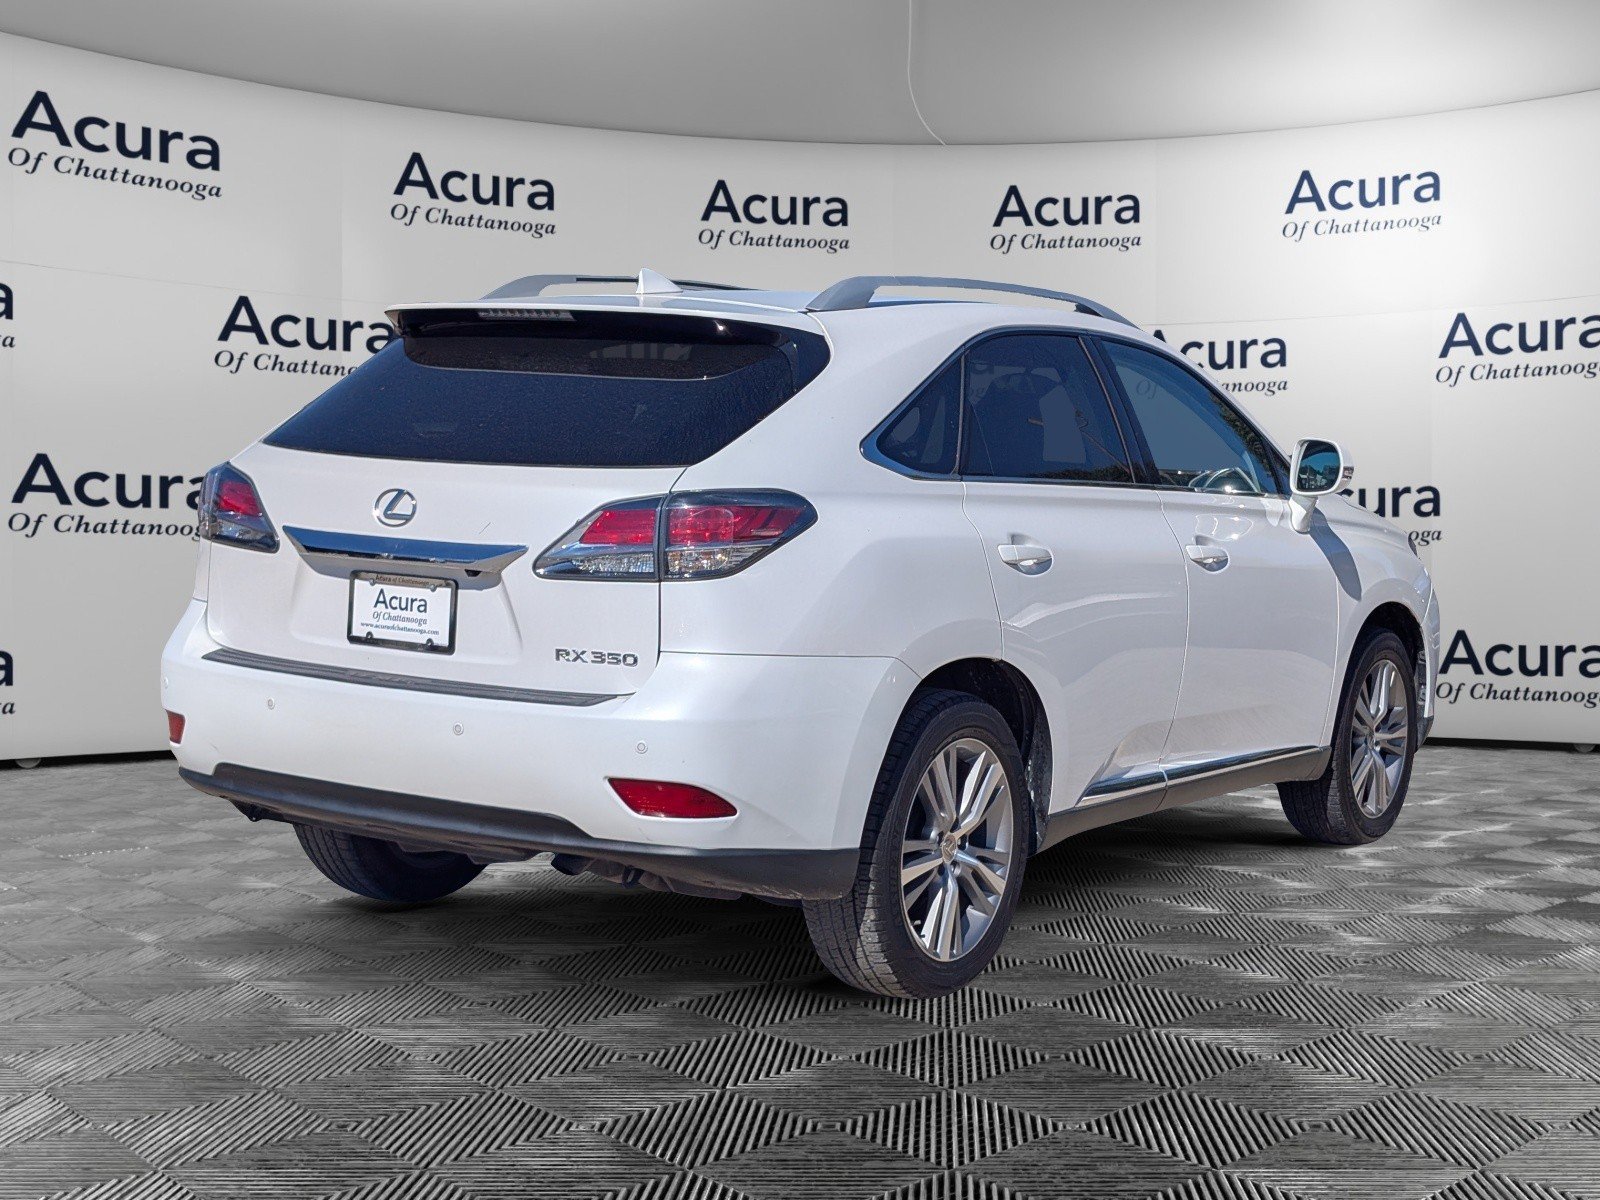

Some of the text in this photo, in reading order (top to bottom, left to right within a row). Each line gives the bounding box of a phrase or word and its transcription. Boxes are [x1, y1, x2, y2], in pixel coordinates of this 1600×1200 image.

[11, 90, 220, 172] Acura
[8, 147, 222, 201] Of Chattanooga
[393, 152, 554, 211] Acura
[1284, 169, 1441, 215] Acura
[391, 203, 556, 239] Of Chattanooga
[701, 179, 849, 227] Acura
[992, 184, 1141, 228] Acura
[698, 228, 850, 254] Of Chattanooga
[990, 233, 1141, 254] Of Chattanooga
[1282, 214, 1442, 242] Of Chattanooga
[217, 295, 395, 354] Acura
[1438, 312, 1600, 359] Acura
[214, 350, 357, 377] Of Chattan
[1153, 329, 1287, 370] cura
[1436, 361, 1600, 388] Of Chattanoog
[1337, 485, 1441, 518] ura
[8, 512, 201, 542] Of Chattanoog
[373, 611, 428, 627] Of Chattanooga
[374, 588, 428, 614] Acura
[1438, 629, 1600, 679] Acura
[1436, 681, 1600, 709] Of Chattanoog
